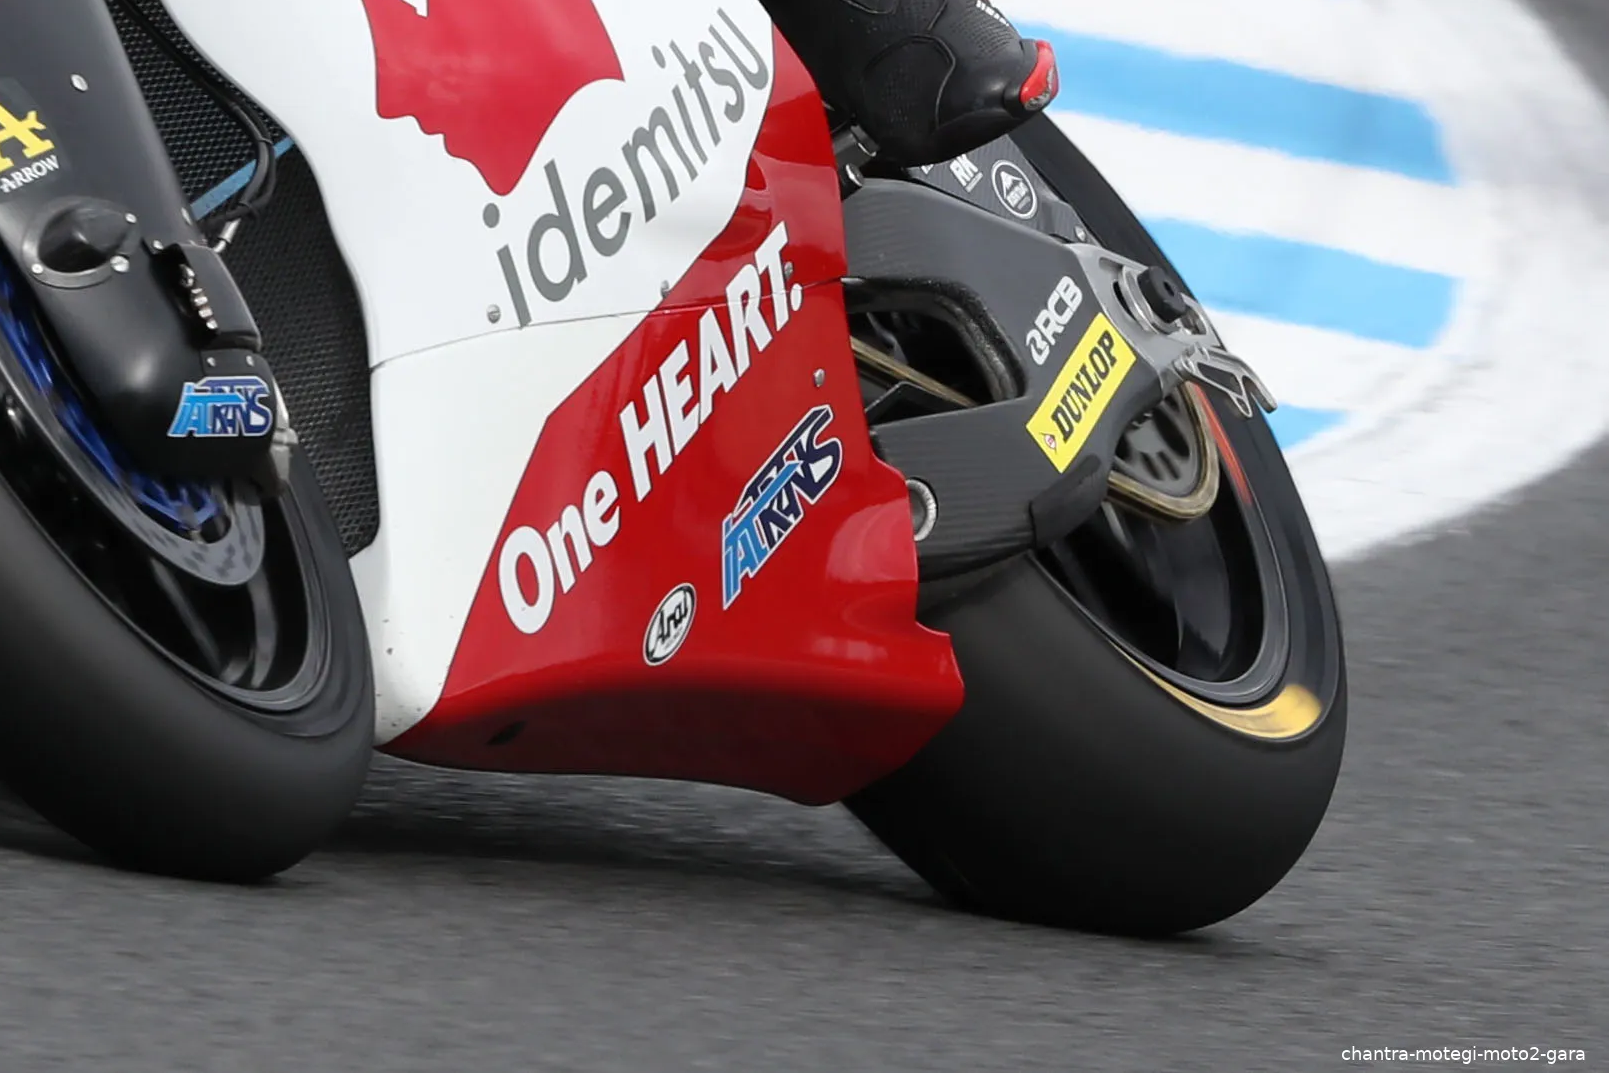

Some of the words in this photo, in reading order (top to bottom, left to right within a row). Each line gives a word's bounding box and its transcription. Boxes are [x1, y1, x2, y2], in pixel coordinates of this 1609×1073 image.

[482, 7, 769, 329] idemitsu
[498, 470, 620, 634] One
[619, 220, 803, 502] HEART.
[1050, 329, 1118, 444] DUNLOP
[650, 587, 688, 659] Arai
